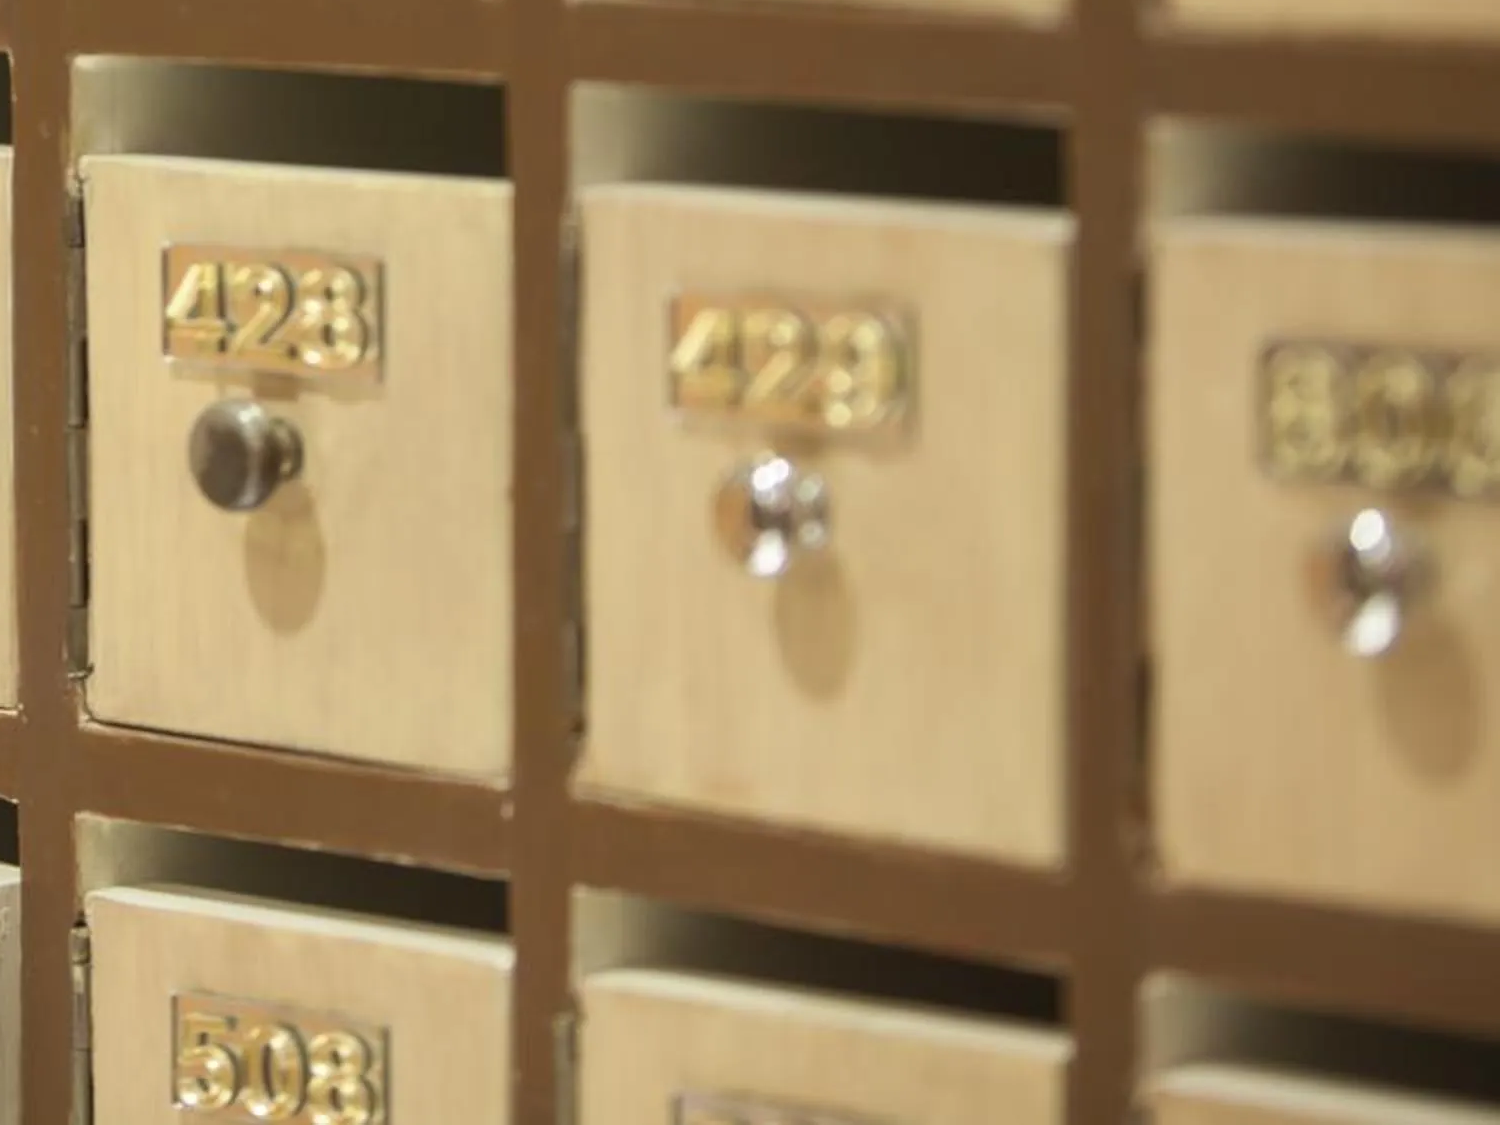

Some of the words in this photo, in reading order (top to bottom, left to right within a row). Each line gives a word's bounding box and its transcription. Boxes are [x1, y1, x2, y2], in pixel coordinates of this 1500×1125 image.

[164, 261, 370, 369] 428
[671, 306, 900, 428] 429
[177, 1010, 376, 1125] 508
